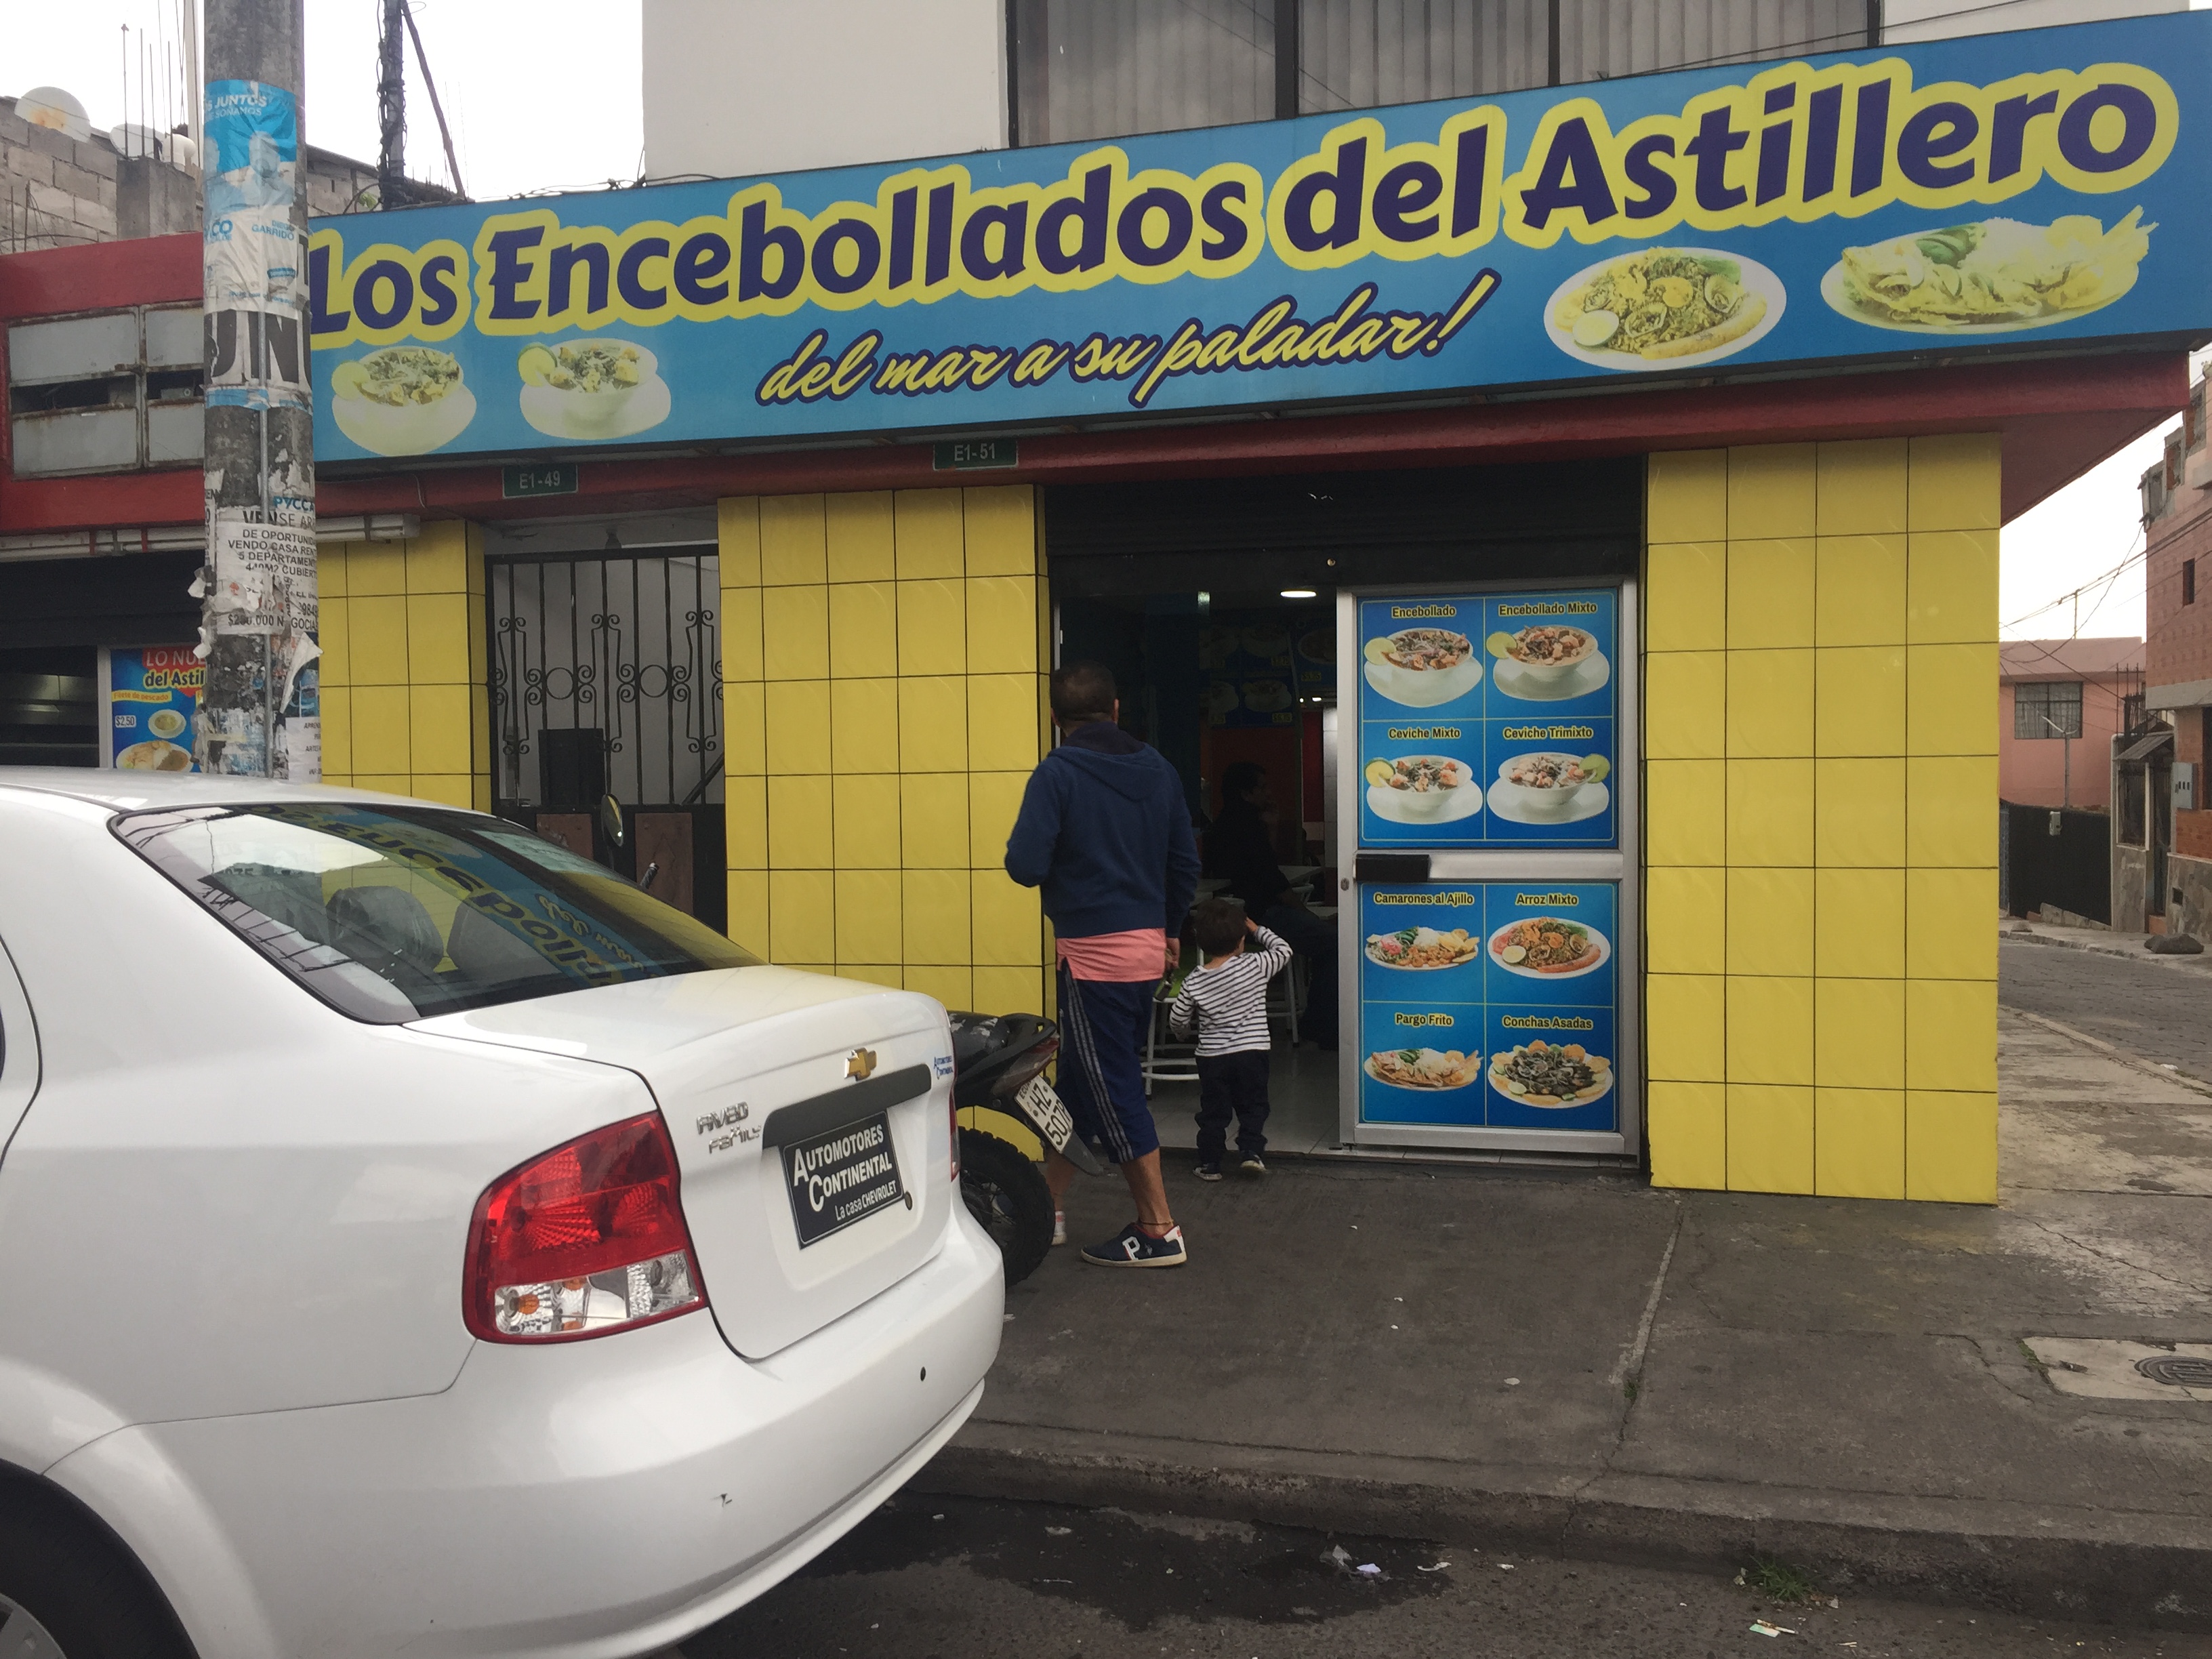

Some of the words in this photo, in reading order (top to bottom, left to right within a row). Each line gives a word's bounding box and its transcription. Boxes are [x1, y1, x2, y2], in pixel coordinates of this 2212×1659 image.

[310, 244, 456, 334] Los
[487, 165, 1248, 319] Encebollados
[1284, 123, 1488, 252] del
[1520, 77, 2158, 230] Astillero
[252, 224, 295, 241] GARRIDO
[756, 330, 881, 405] del
[873, 346, 1015, 393] mar
[1012, 342, 1072, 385] a
[1071, 334, 1160, 377] su
[1131, 270, 1498, 405] paladar!
[954, 443, 996, 462] E1-51
[519, 470, 561, 489] E1-49
[228, 539, 268, 550] VENDO
[270, 542, 299, 554] CASA
[1392, 605, 1456, 617] Encebollado
[1499, 602, 1565, 615] Encebollado
[1568, 601, 1597, 613] Mixto
[146, 651, 167, 666] LO
[144, 670, 168, 687] del
[1389, 727, 1429, 738] Ceviche
[1433, 726, 1460, 738] Mixto
[1504, 727, 1547, 739] Ceviche
[1549, 726, 1593, 738] Trimixto
[1374, 893, 1433, 904] Camarones
[1435, 893, 1446, 904] al
[1447, 893, 1473, 907] Ajillo
[1515, 893, 1545, 905] Arroz
[1549, 893, 1578, 905] Mixto
[1396, 1014, 1426, 1027] Pargo
[1429, 1015, 1452, 1026] Frito
[1503, 1017, 1549, 1028] Conchas
[1552, 1017, 1593, 1029] Asadas
[697, 1101, 748, 1134] AVEO
[794, 1124, 884, 1186] AUTOMOTORES
[809, 1151, 893, 1212] CONTINENTAL
[835, 1205, 846, 1221] La
[846, 1198, 862, 1216] casa
[861, 1180, 897, 1208] CHEVROLET
